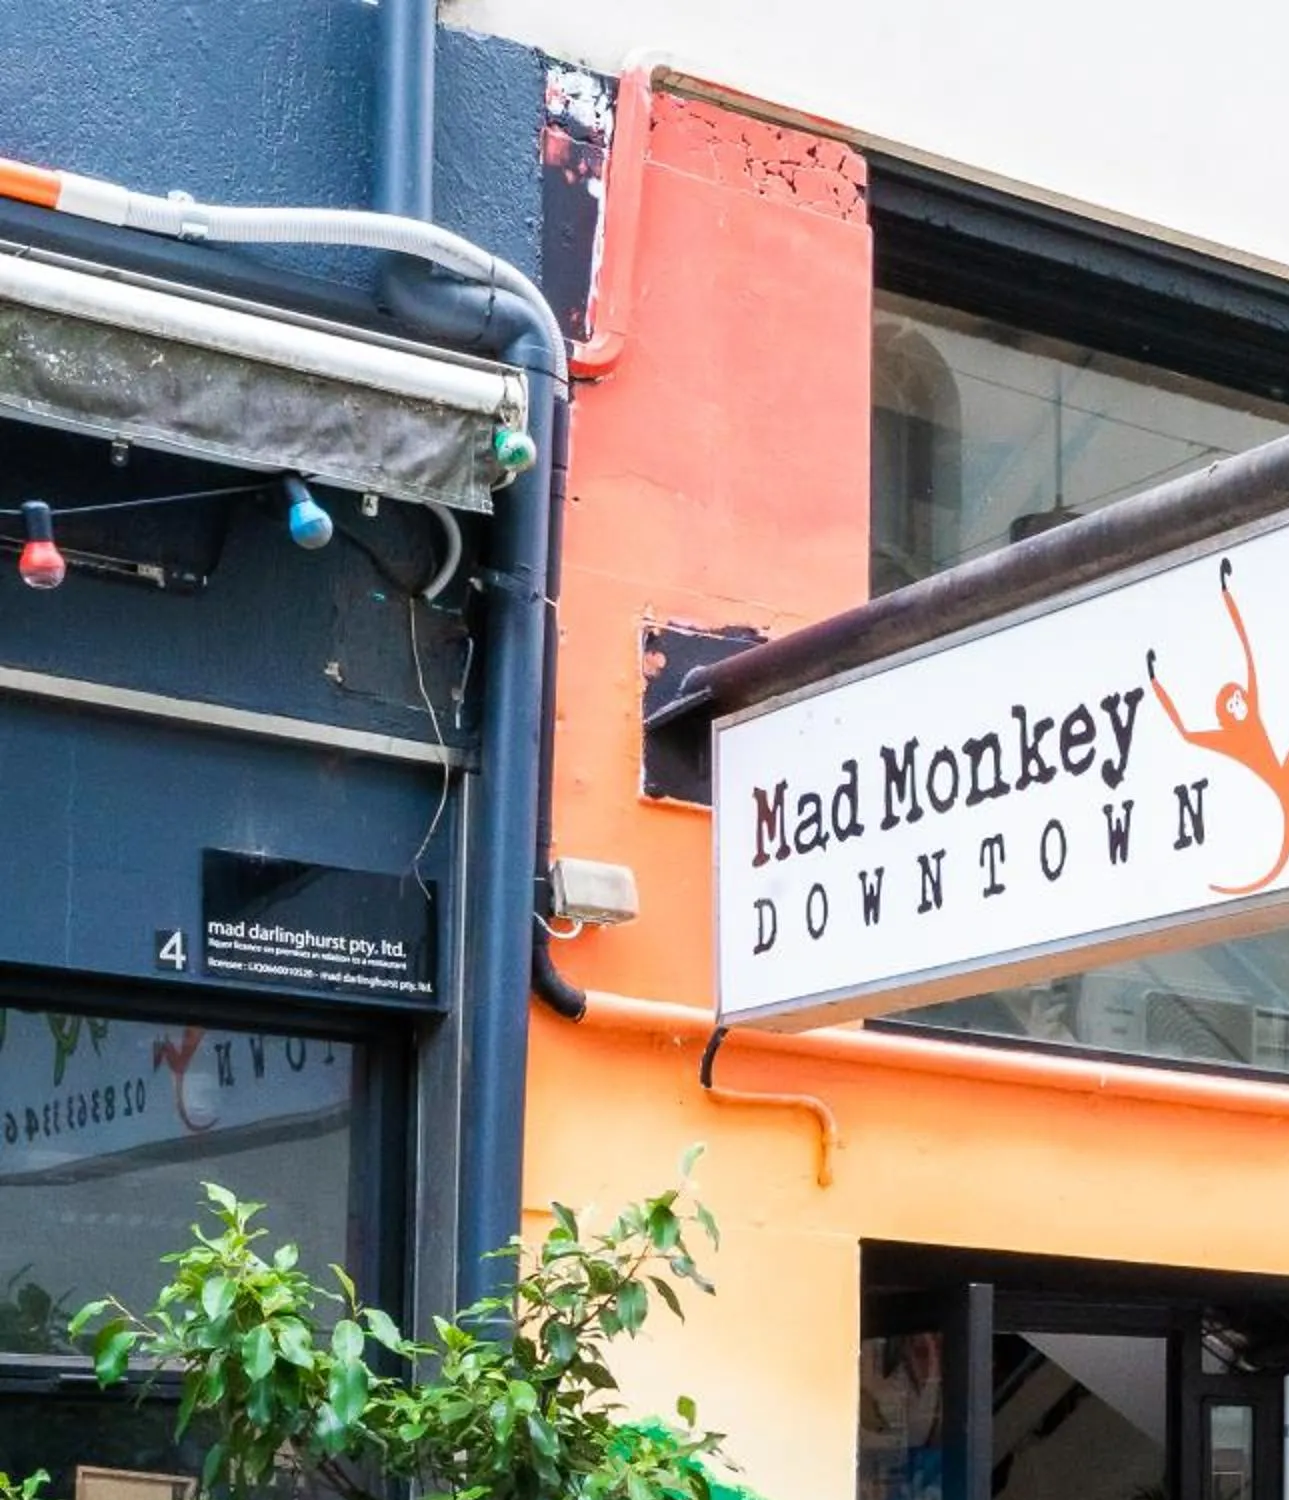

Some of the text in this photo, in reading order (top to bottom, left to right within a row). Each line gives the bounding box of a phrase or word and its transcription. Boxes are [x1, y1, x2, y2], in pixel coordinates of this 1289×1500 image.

[752, 687, 1145, 868] Mad Monkey
[752, 779, 1209, 955] DOWNTOWN
[159, 931, 186, 970] 4
[207, 921, 406, 958] mad darlinghurst pty. ltd.
